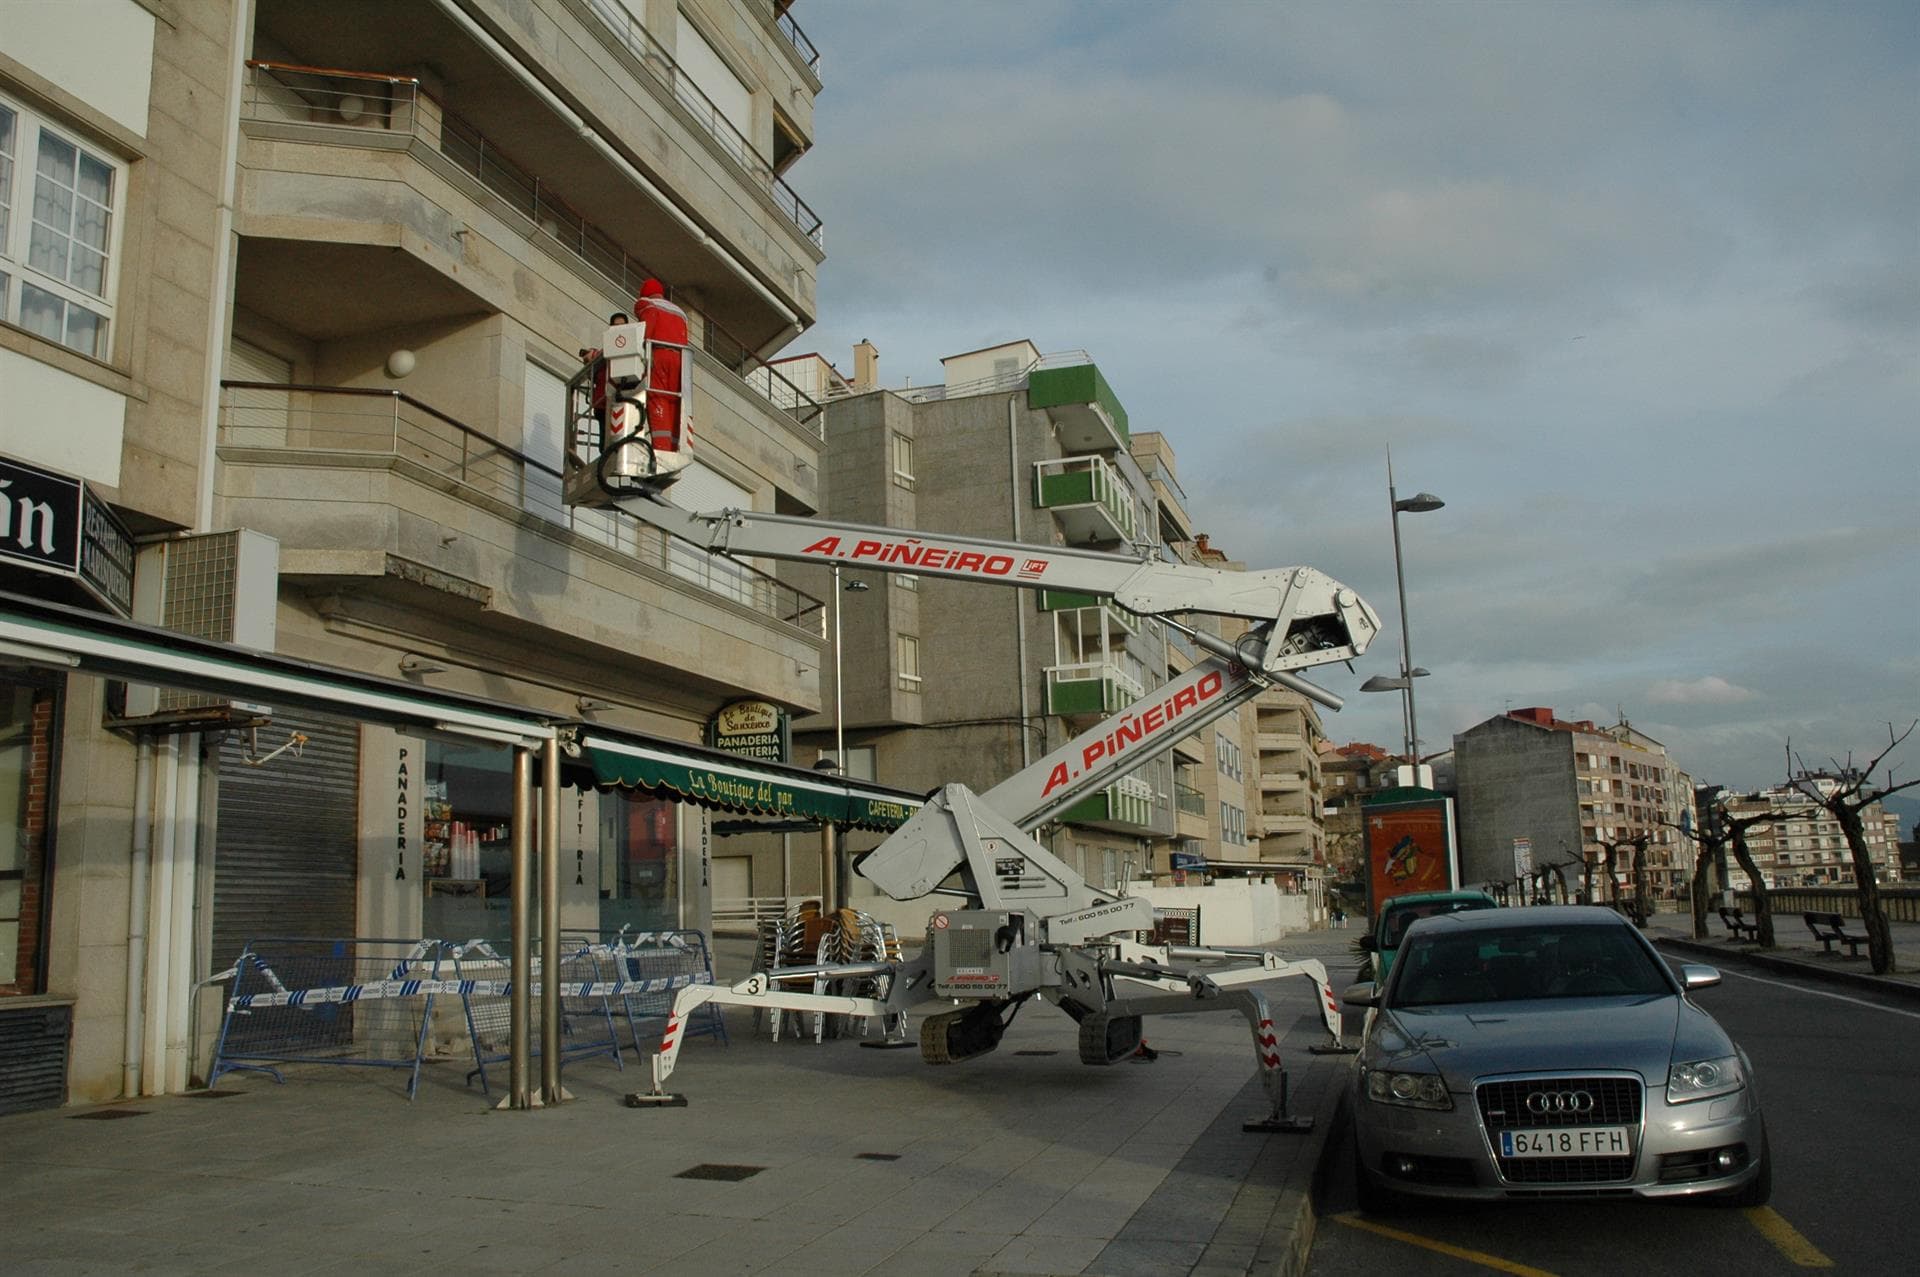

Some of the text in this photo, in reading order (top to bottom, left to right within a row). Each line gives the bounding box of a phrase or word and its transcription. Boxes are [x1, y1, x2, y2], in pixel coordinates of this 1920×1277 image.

[738, 703, 773, 719] Boutique
[744, 714, 756, 722] de
[717, 734, 780, 748] PANADERIA
[689, 770, 793, 812] La Boutique del pan
[395, 748, 408, 881] PANADERIA
[868, 799, 904, 819] CAFETERIA
[1110, 905, 1123, 914] 00
[1123, 902, 1135, 910] 77
[1269, 955, 1276, 969] 1
[747, 978, 759, 995] 3
[1194, 981, 1205, 999] 2
[1515, 1132, 1572, 1153] 6418
[1579, 1131, 1623, 1152] FFH
